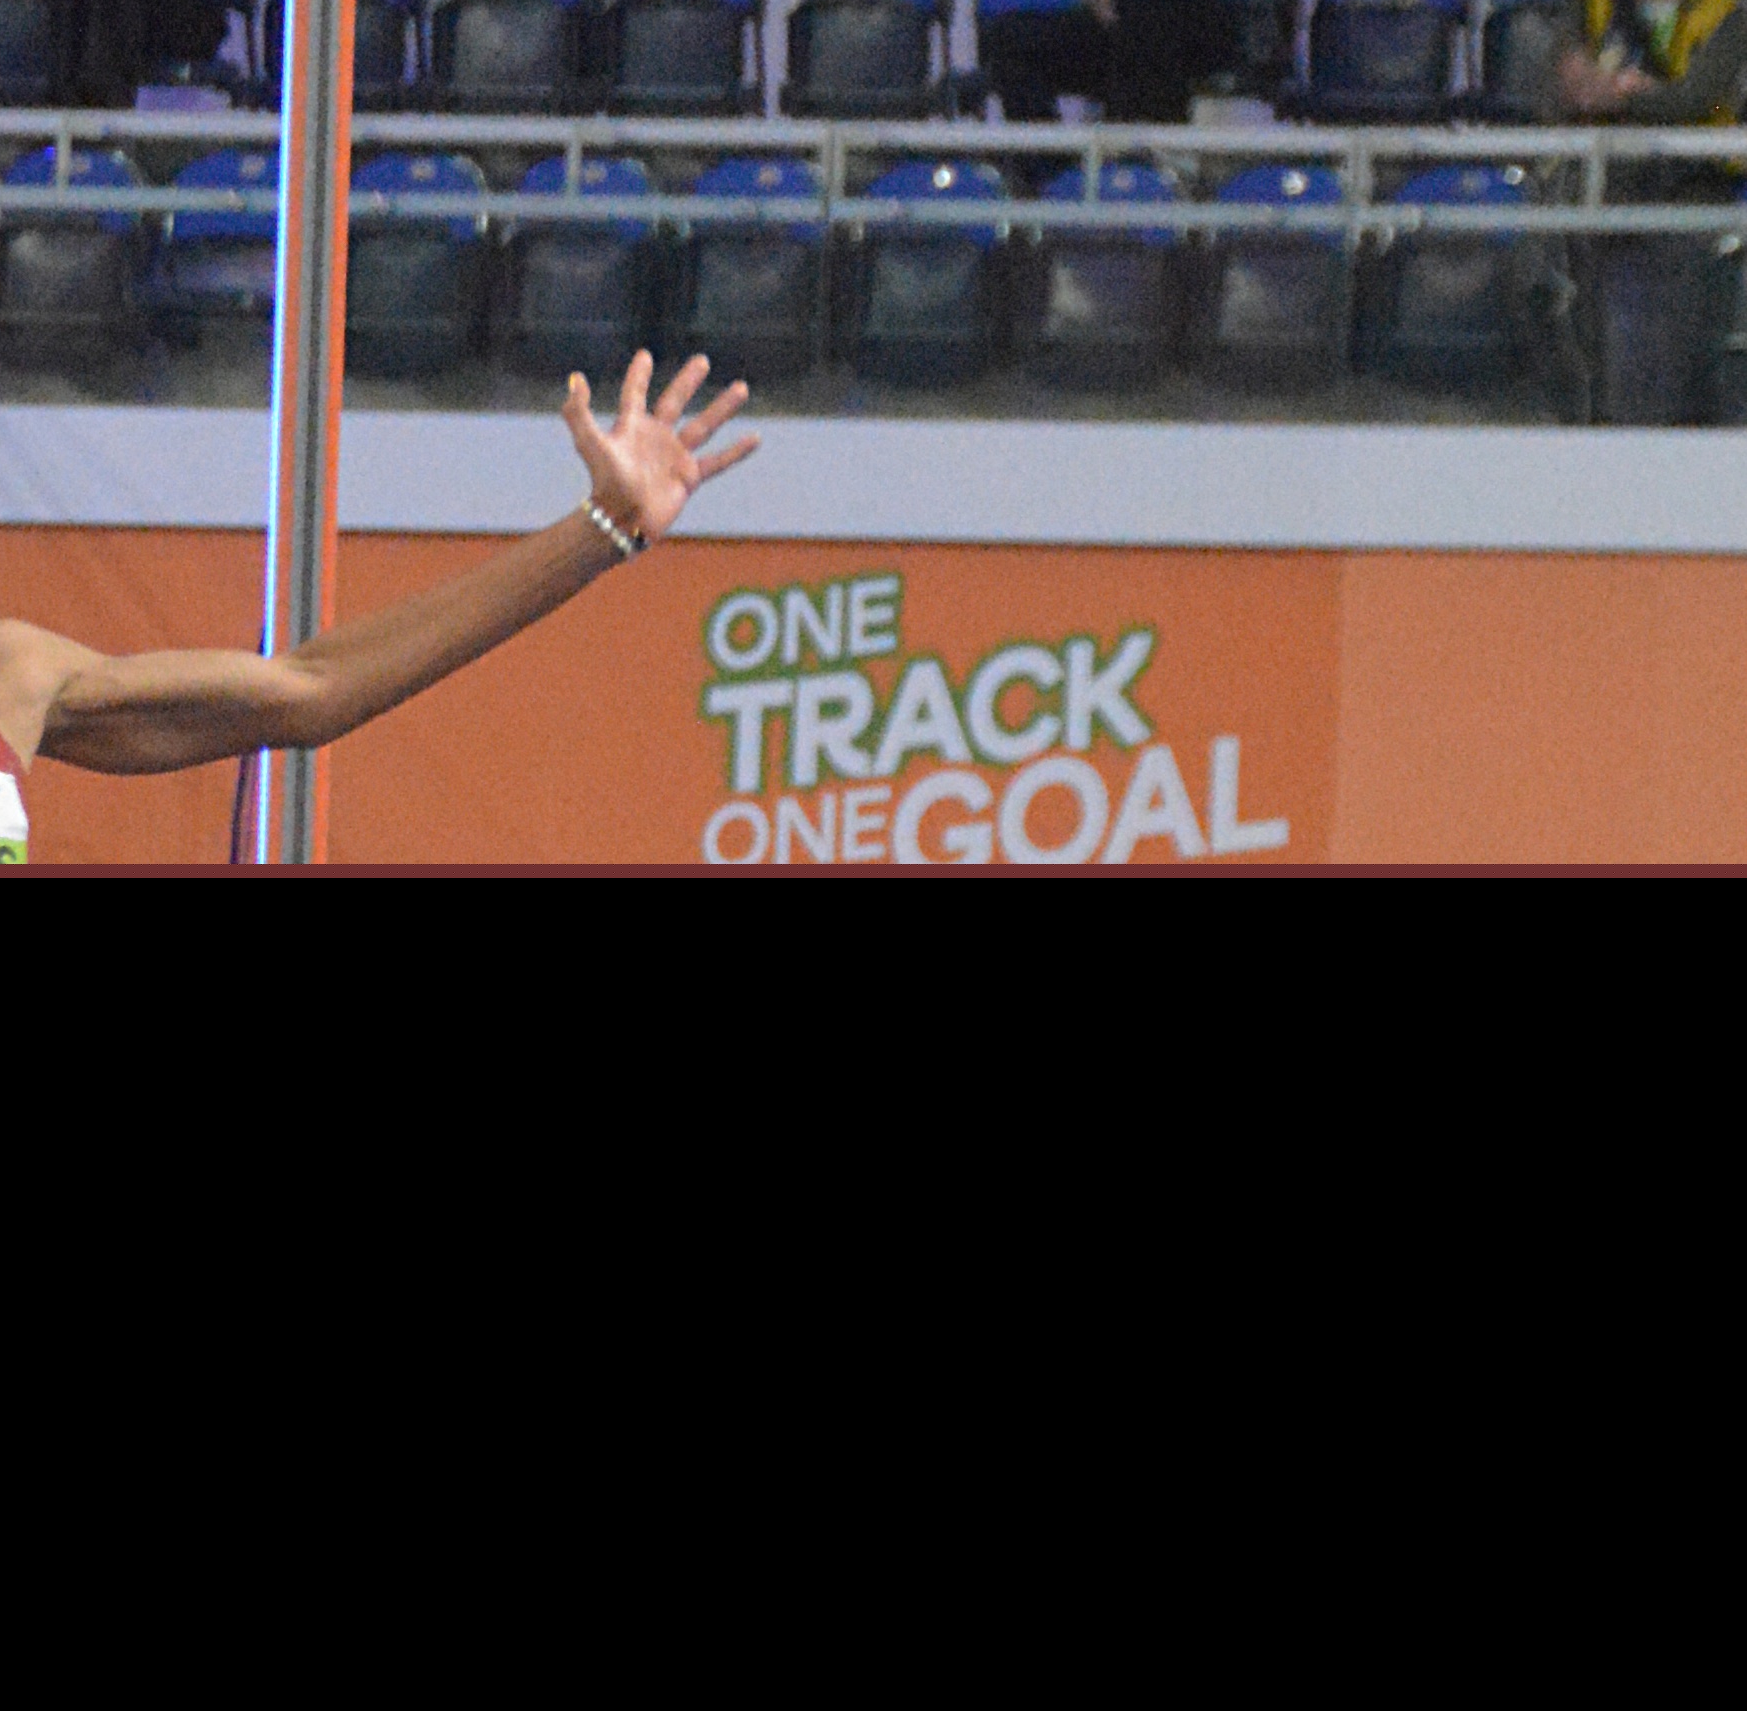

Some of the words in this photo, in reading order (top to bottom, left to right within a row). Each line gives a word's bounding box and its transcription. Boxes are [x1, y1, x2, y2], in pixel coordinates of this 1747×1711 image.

[709, 577, 899, 669] ONE
[705, 630, 1154, 790] TRACK
[703, 788, 891, 864] ONE
[894, 736, 1290, 864] GOAL
